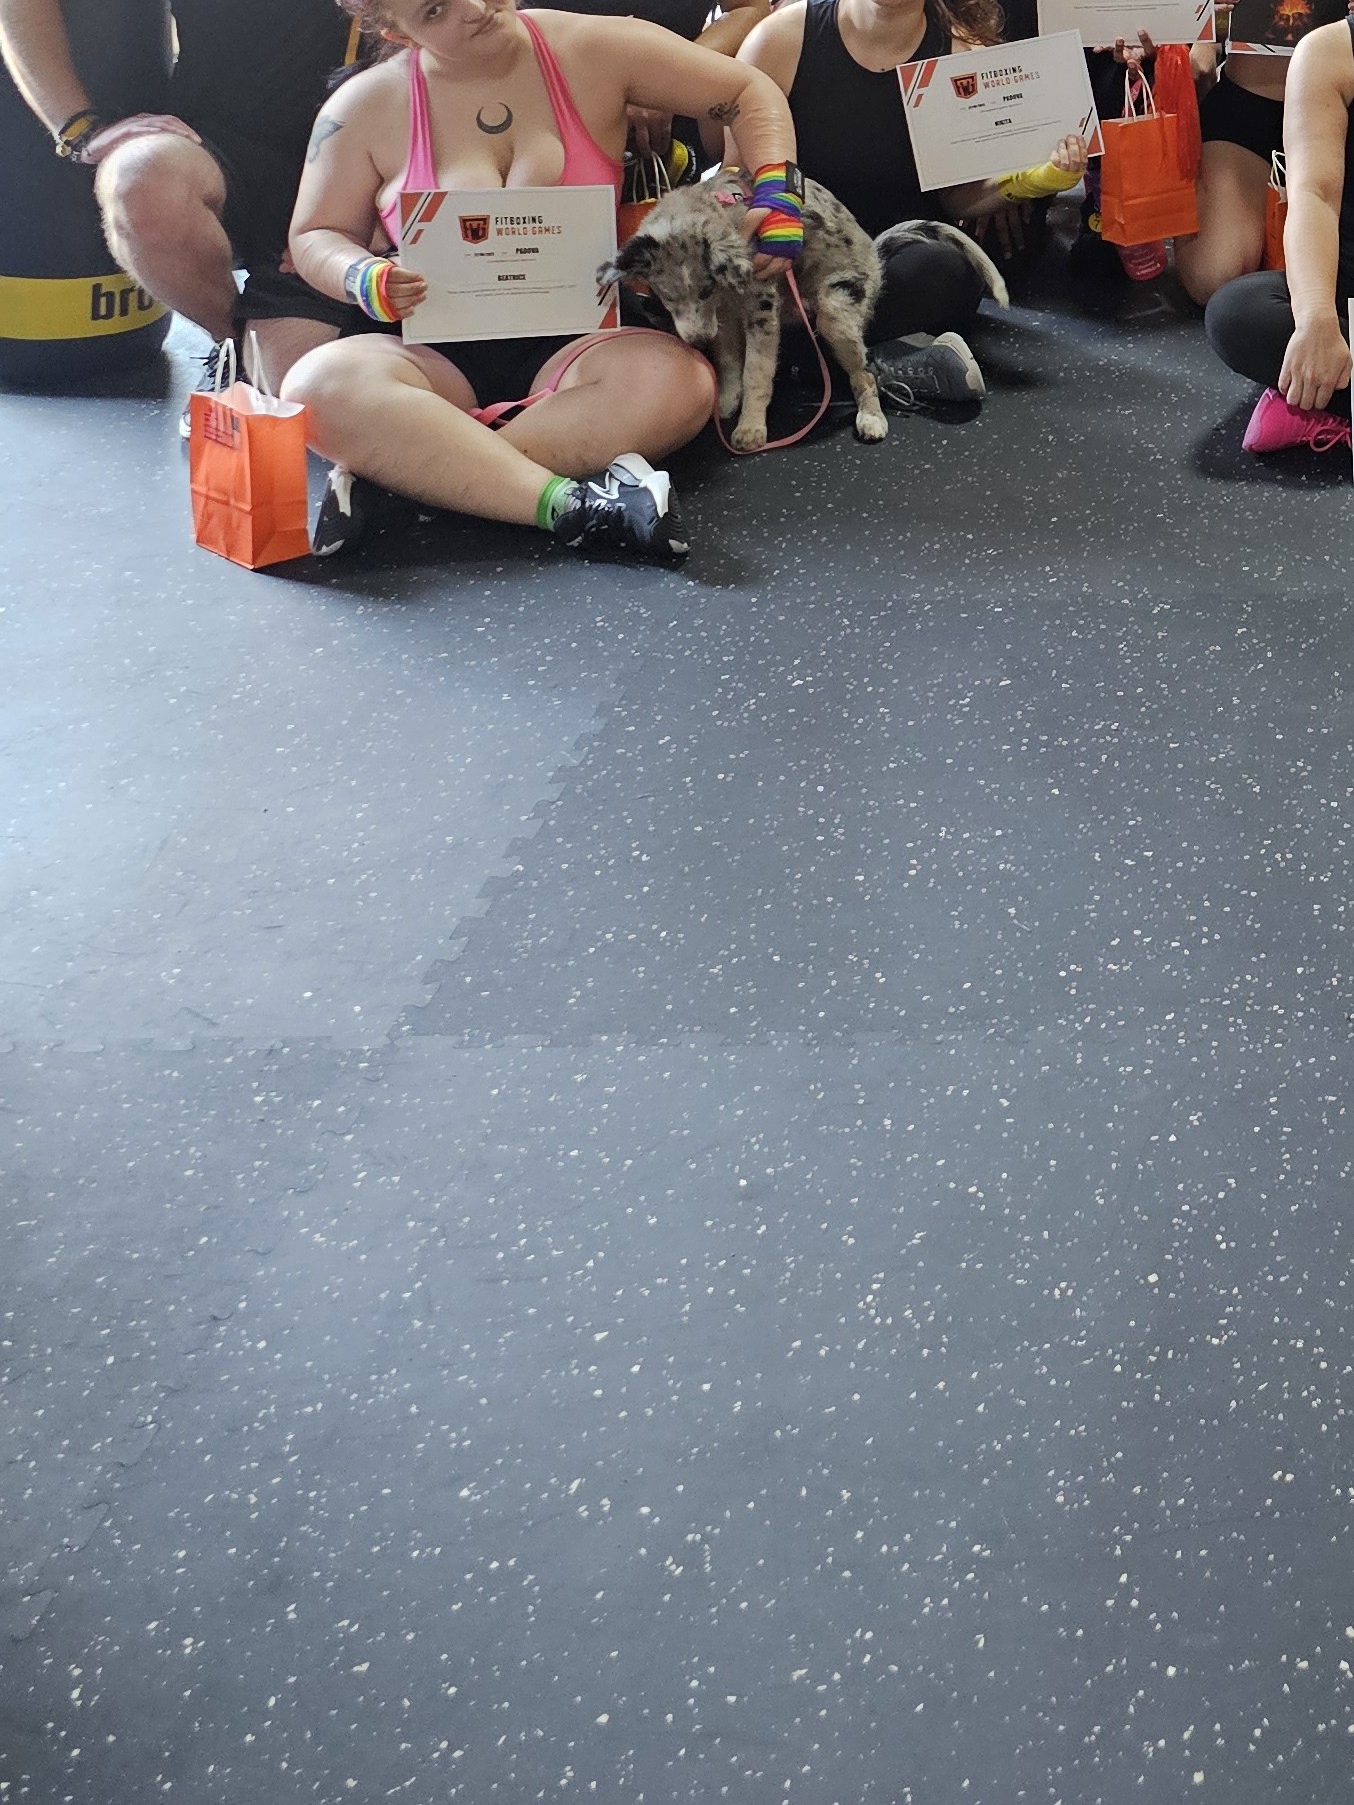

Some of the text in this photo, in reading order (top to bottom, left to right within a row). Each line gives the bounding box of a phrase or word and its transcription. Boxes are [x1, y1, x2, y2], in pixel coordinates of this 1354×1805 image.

[981, 65, 1023, 80] FITBOXING
[982, 71, 1041, 89] WORLD GAMES
[495, 215, 544, 225] FITBOXING
[496, 225, 562, 236] WORLD GAMES
